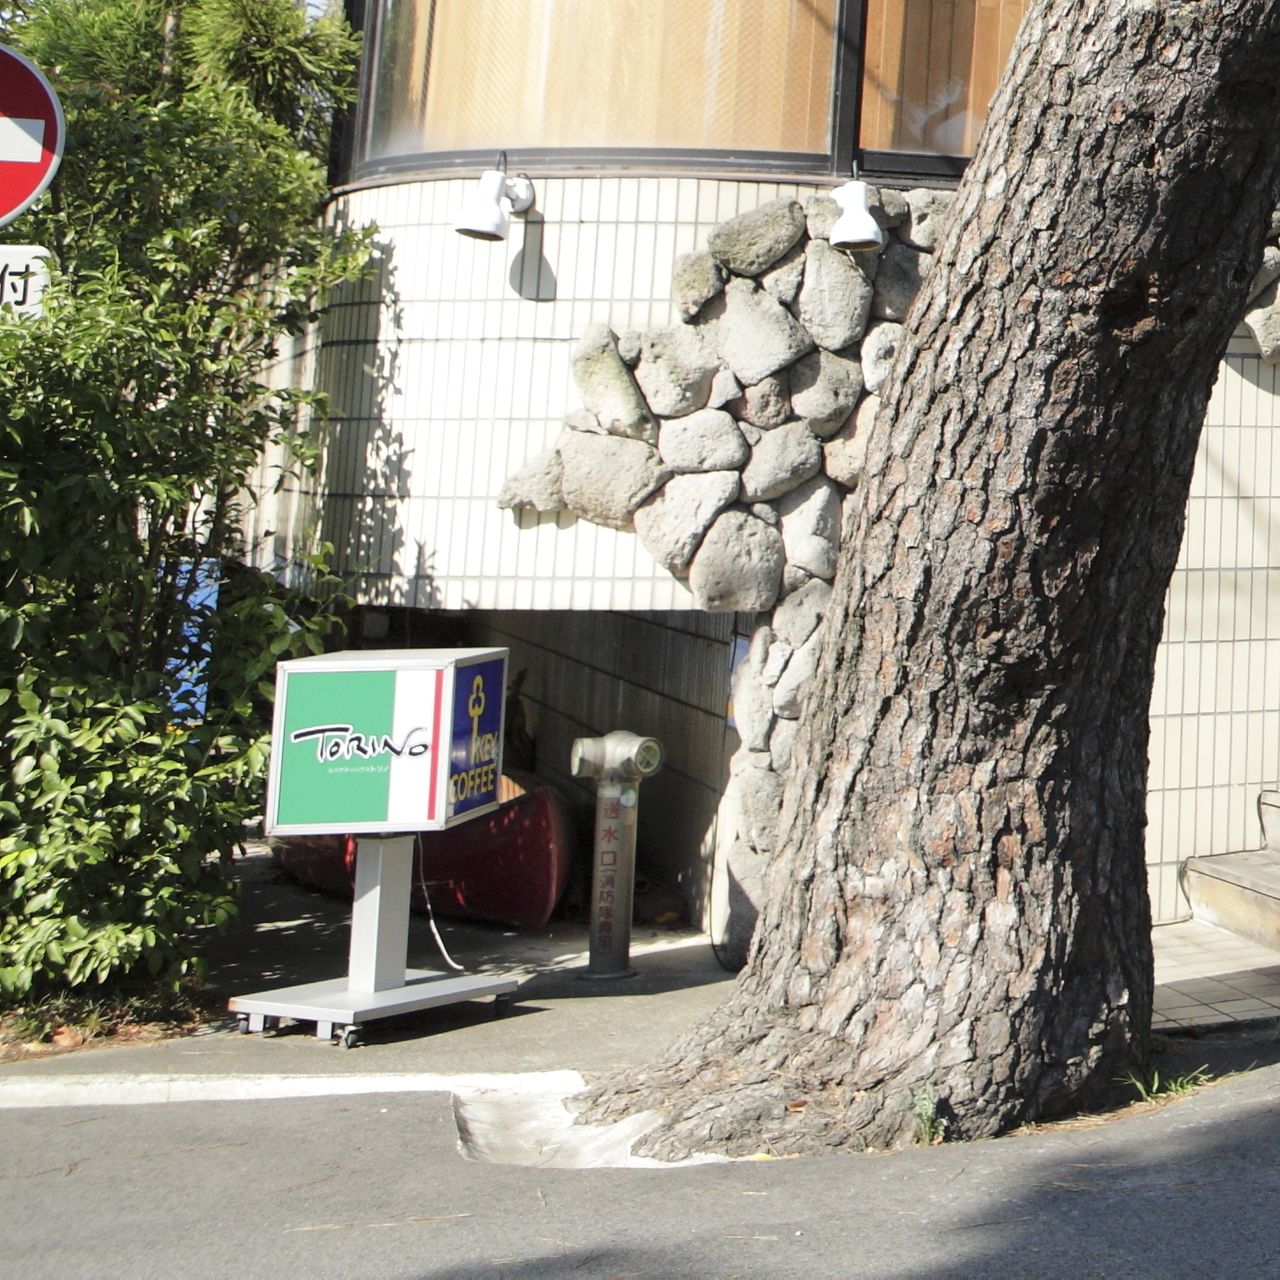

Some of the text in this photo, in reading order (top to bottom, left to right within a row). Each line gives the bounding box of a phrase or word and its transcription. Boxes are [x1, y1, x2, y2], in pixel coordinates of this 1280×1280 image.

[292, 725, 430, 759] TORINO
[470, 731, 499, 765] KEY
[450, 763, 497, 803] COFFEE
